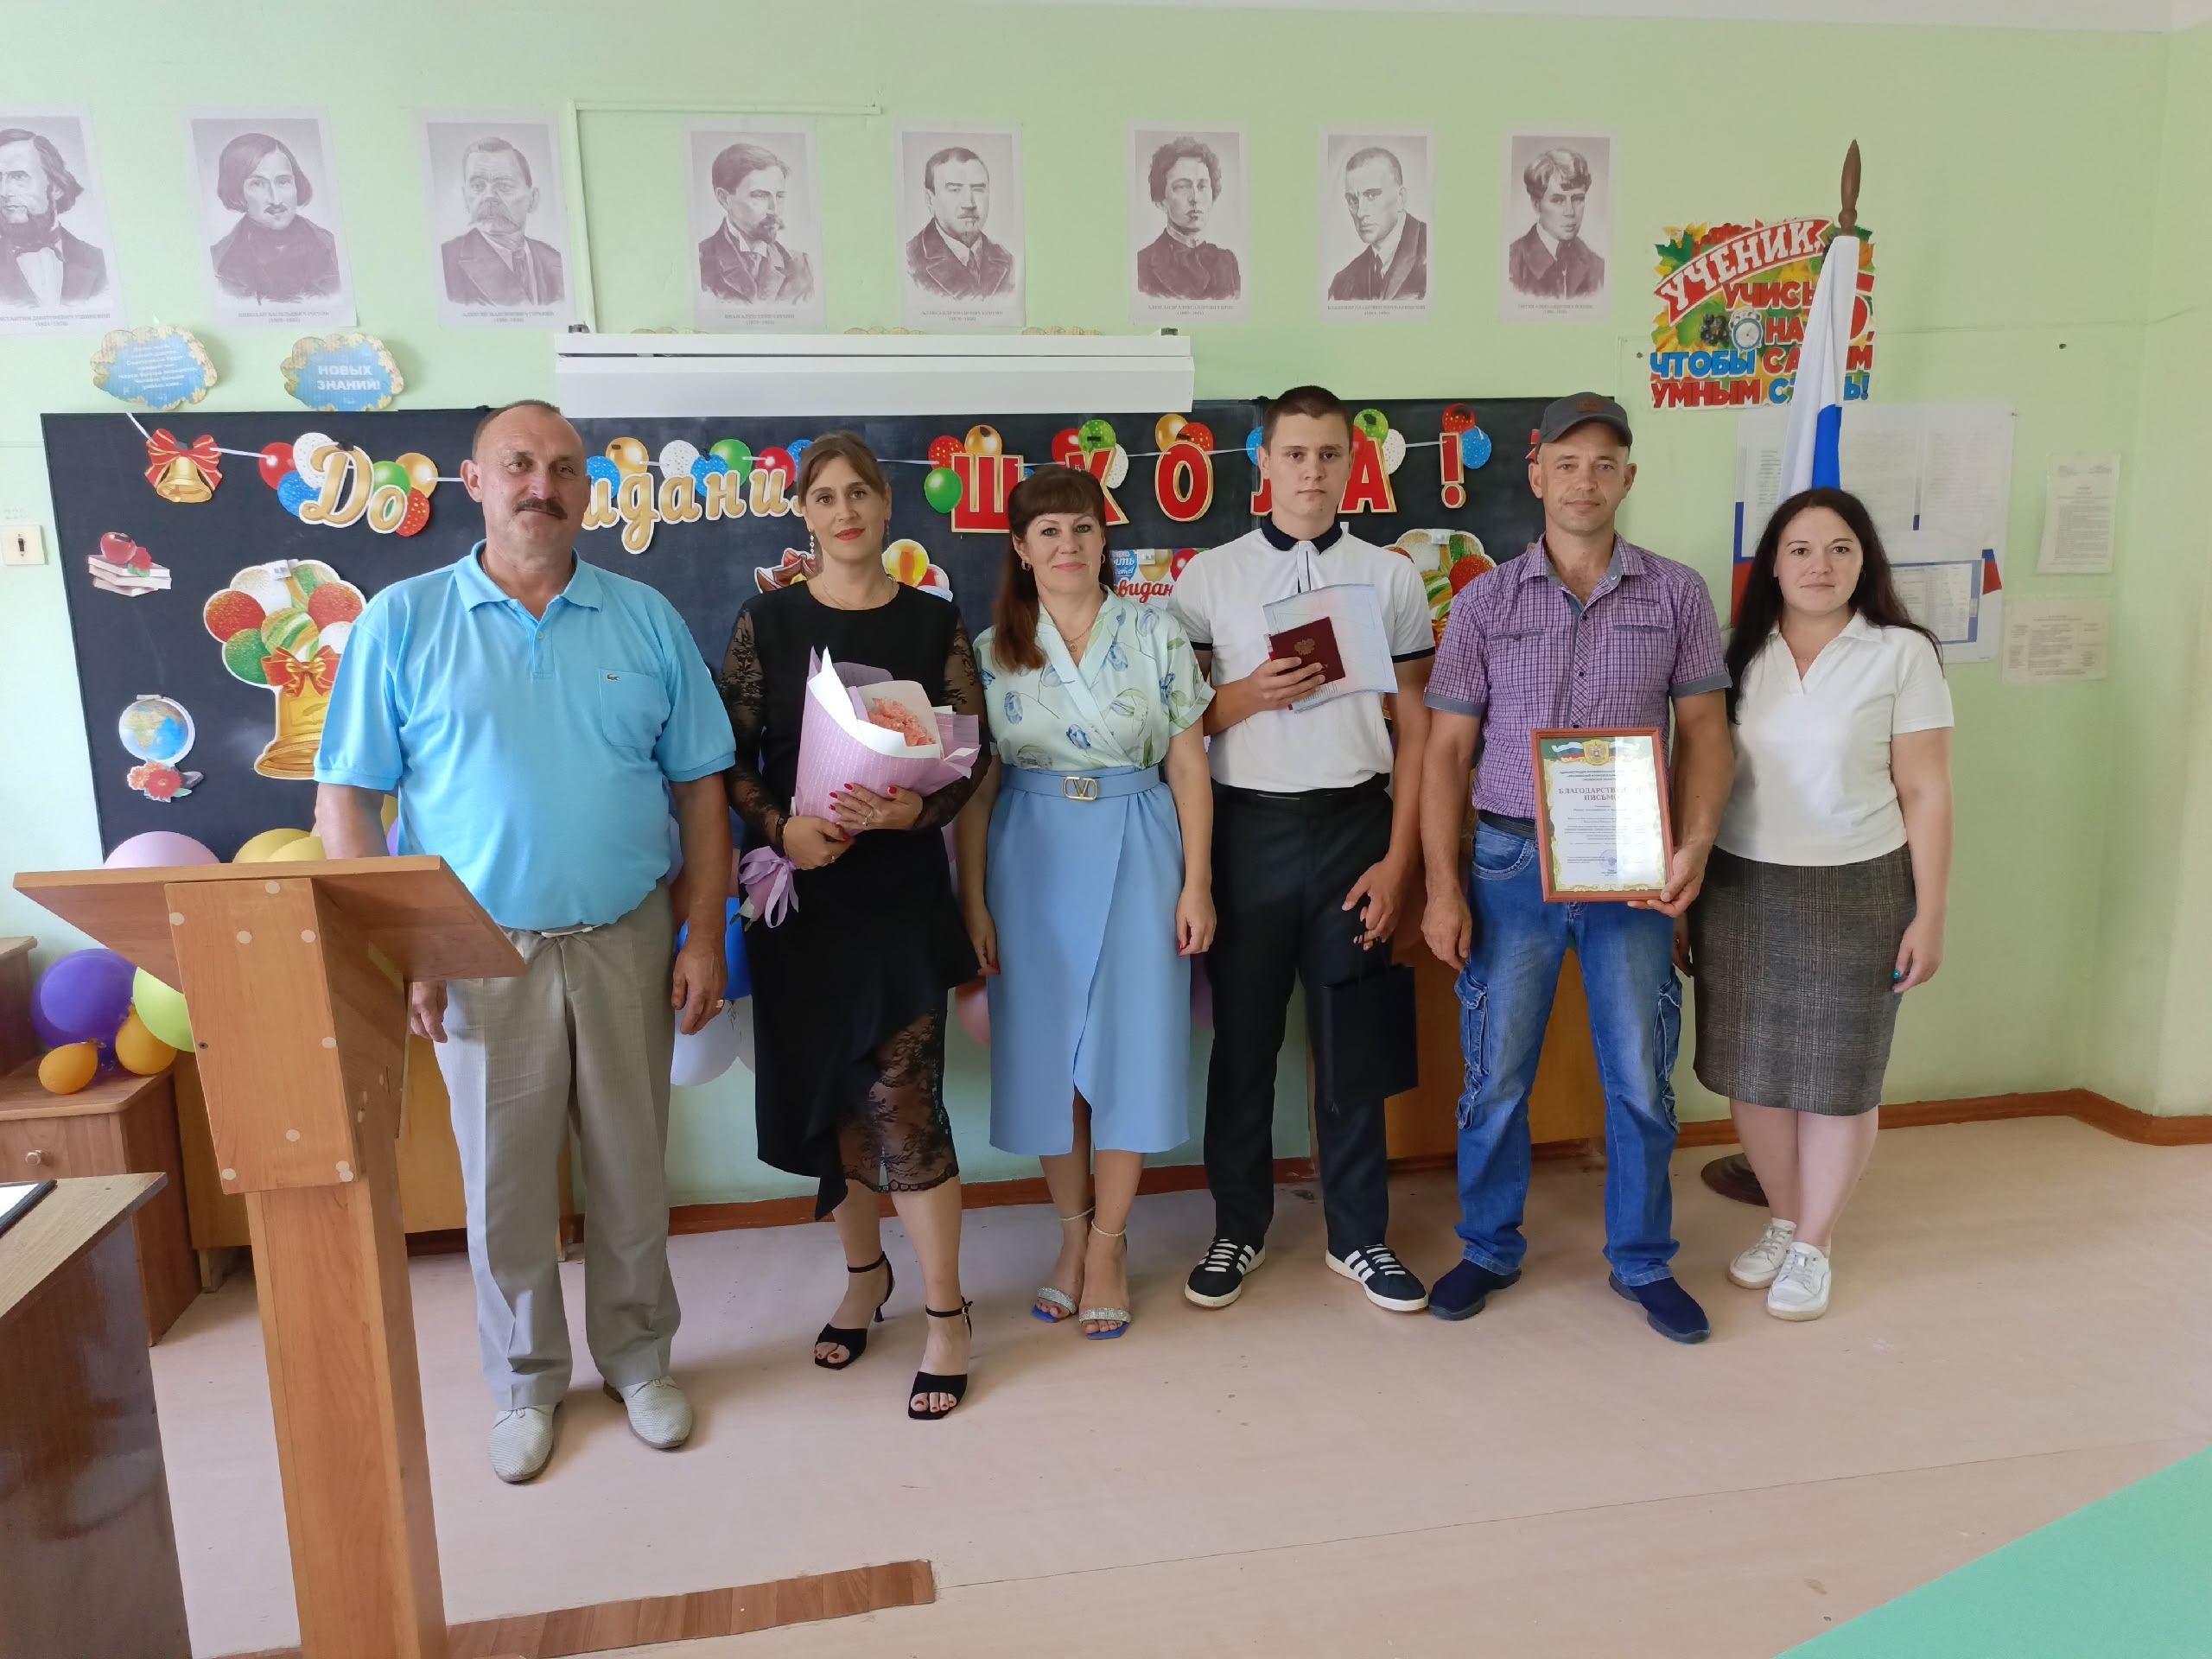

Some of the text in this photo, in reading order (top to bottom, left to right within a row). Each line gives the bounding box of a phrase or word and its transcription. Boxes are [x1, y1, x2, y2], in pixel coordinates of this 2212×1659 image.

[1661, 221, 1821, 311] УЧЕНИК,
[1766, 317, 1804, 344] НА
[318, 365, 372, 375] НОВЫХ
[1649, 345, 1872, 378] ЧТОБЫ САМ
[317, 378, 380, 391] ЗНАНИЙ!
[1652, 373, 1870, 408] УМНЫМ СЬ!
[299, 442, 408, 534] До
